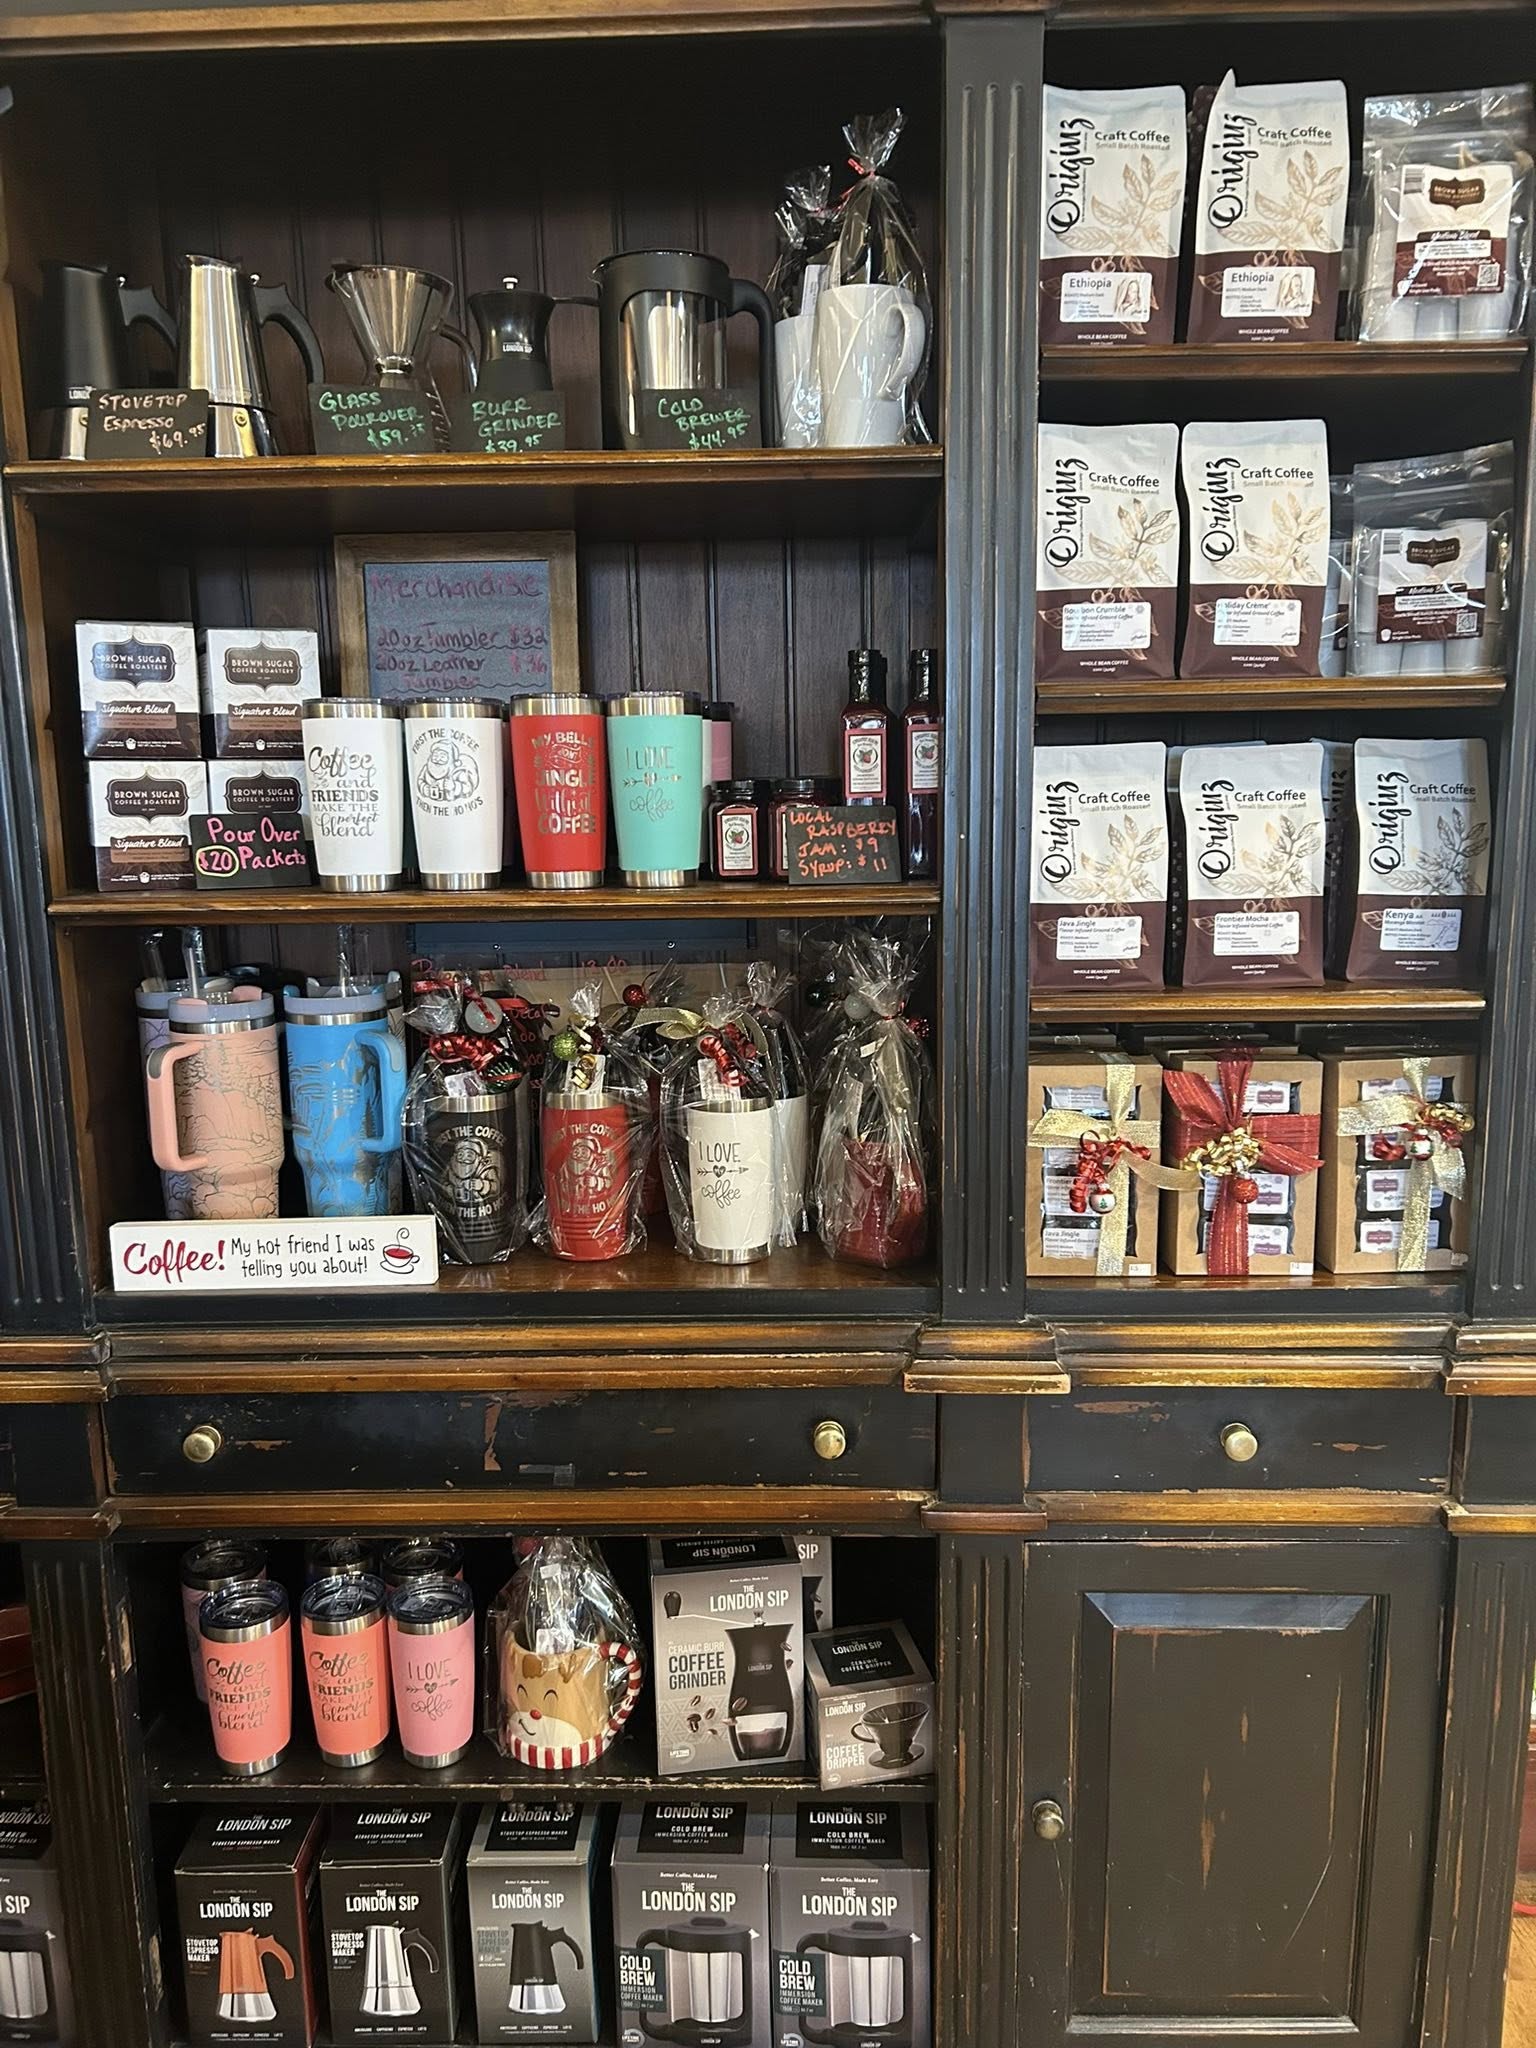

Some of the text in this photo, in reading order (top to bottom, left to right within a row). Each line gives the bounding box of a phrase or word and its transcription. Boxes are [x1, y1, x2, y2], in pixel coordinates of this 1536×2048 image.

[1095, 130, 1170, 143] Craft Coffee
[1257, 127, 1332, 140] Craft Coffee
[1047, 118, 1095, 234] Originz
[1208, 114, 1259, 228] Originz
[1069, 277, 1112, 290] Ethiopia
[1231, 272, 1275, 285] Ethiopia
[99, 394, 188, 411] STOVETOP
[319, 391, 382, 411] GLASS
[472, 398, 531, 421] BURR
[657, 398, 703, 418] COLD
[103, 415, 173, 432] Espresso
[332, 406, 424, 431] POUROVER
[478, 413, 561, 437] GRINDER
[676, 407, 751, 431] BREWER
[688, 422, 748, 451] $44.95
[1089, 472, 1160, 487] Craft Coffee
[1241, 467, 1314, 479] Craft Coffee
[1045, 458, 1091, 567] Originz
[1200, 457, 1243, 562] Originz
[370, 567, 543, 602] Merchandise
[1096, 606, 1126, 614] Crumble
[422, 622, 498, 648] Tumbler
[509, 624, 548, 648] $32
[232, 659, 294, 668] BROWN SUGAR
[101, 703, 172, 717] Signature Blend
[232, 705, 298, 719] Signature Blend
[412, 733, 428, 755] FIRST
[428, 728, 446, 740] THE
[308, 746, 374, 778] Coffee
[625, 747, 675, 770] I LOVE
[336, 767, 376, 789] and
[114, 790, 180, 799] BROWN SUGAR
[232, 788, 294, 797] BROWN SUGAR
[311, 789, 380, 802] FRIENDS
[1078, 790, 1151, 805] Craft Coffee
[1234, 790, 1306, 803] Craft Coffee
[1409, 783, 1476, 795] Craft Coffee
[313, 803, 379, 812] MAKE THE
[433, 805, 450, 817] THE
[629, 788, 675, 822] coffee
[315, 813, 375, 837] blend
[336, 812, 380, 826] perfect
[538, 813, 596, 834] COFFEE
[790, 811, 832, 825] LOCAL
[1369, 771, 1412, 875] Originz
[207, 816, 300, 843] Pour Over
[806, 818, 897, 839] RASPBERRY
[1040, 780, 1081, 883] Originz
[1198, 779, 1239, 880] Originz
[114, 837, 183, 852] Signature Blend
[199, 846, 306, 871] $20 Packets
[1385, 910, 1414, 920] Kenya
[1076, 920, 1096, 928] Jingle
[699, 1141, 742, 1163] I LOVE
[701, 1178, 742, 1210] coffee
[123, 1234, 375, 1284] Coffee! My hot friend I was
[241, 1256, 368, 1279] telling you about!
[798, 1544, 818, 1560] SIP
[710, 1590, 789, 1612] LONDON SIP
[668, 1641, 725, 1655] CERAMIC BURR
[407, 1658, 453, 1682] I LOVE
[668, 1651, 725, 1674] COFFEE
[669, 1670, 727, 1690] GRINDER
[411, 1695, 453, 1721] coffee
[825, 1701, 867, 1718] LONDON SIP
[826, 1744, 864, 1760] COFFEE
[826, 1756, 865, 1770] DRIPPER
[656, 1806, 733, 1819] LONDON SIP
[6, 1896, 30, 1914] SIP
[346, 1895, 419, 1912] LONDON SIP
[492, 1893, 564, 1909] LONDON SIP
[642, 1891, 737, 1913] LONDON SIP
[802, 1895, 897, 1917] LONDON SIP
[200, 1902, 273, 1919] LONDON SIP
[186, 1939, 218, 1947] STOVETOP
[331, 1932, 364, 1941] STOVETOP
[331, 1940, 365, 1949] ESPRESSO
[187, 1946, 219, 1955] ESPRESSO
[188, 1953, 210, 1962] MAKER
[332, 1948, 356, 1956] MAKER
[620, 1955, 651, 1971] COLD
[779, 1959, 811, 1975] COLD
[620, 1970, 656, 1986] BREW
[780, 1974, 816, 1990] BREW
